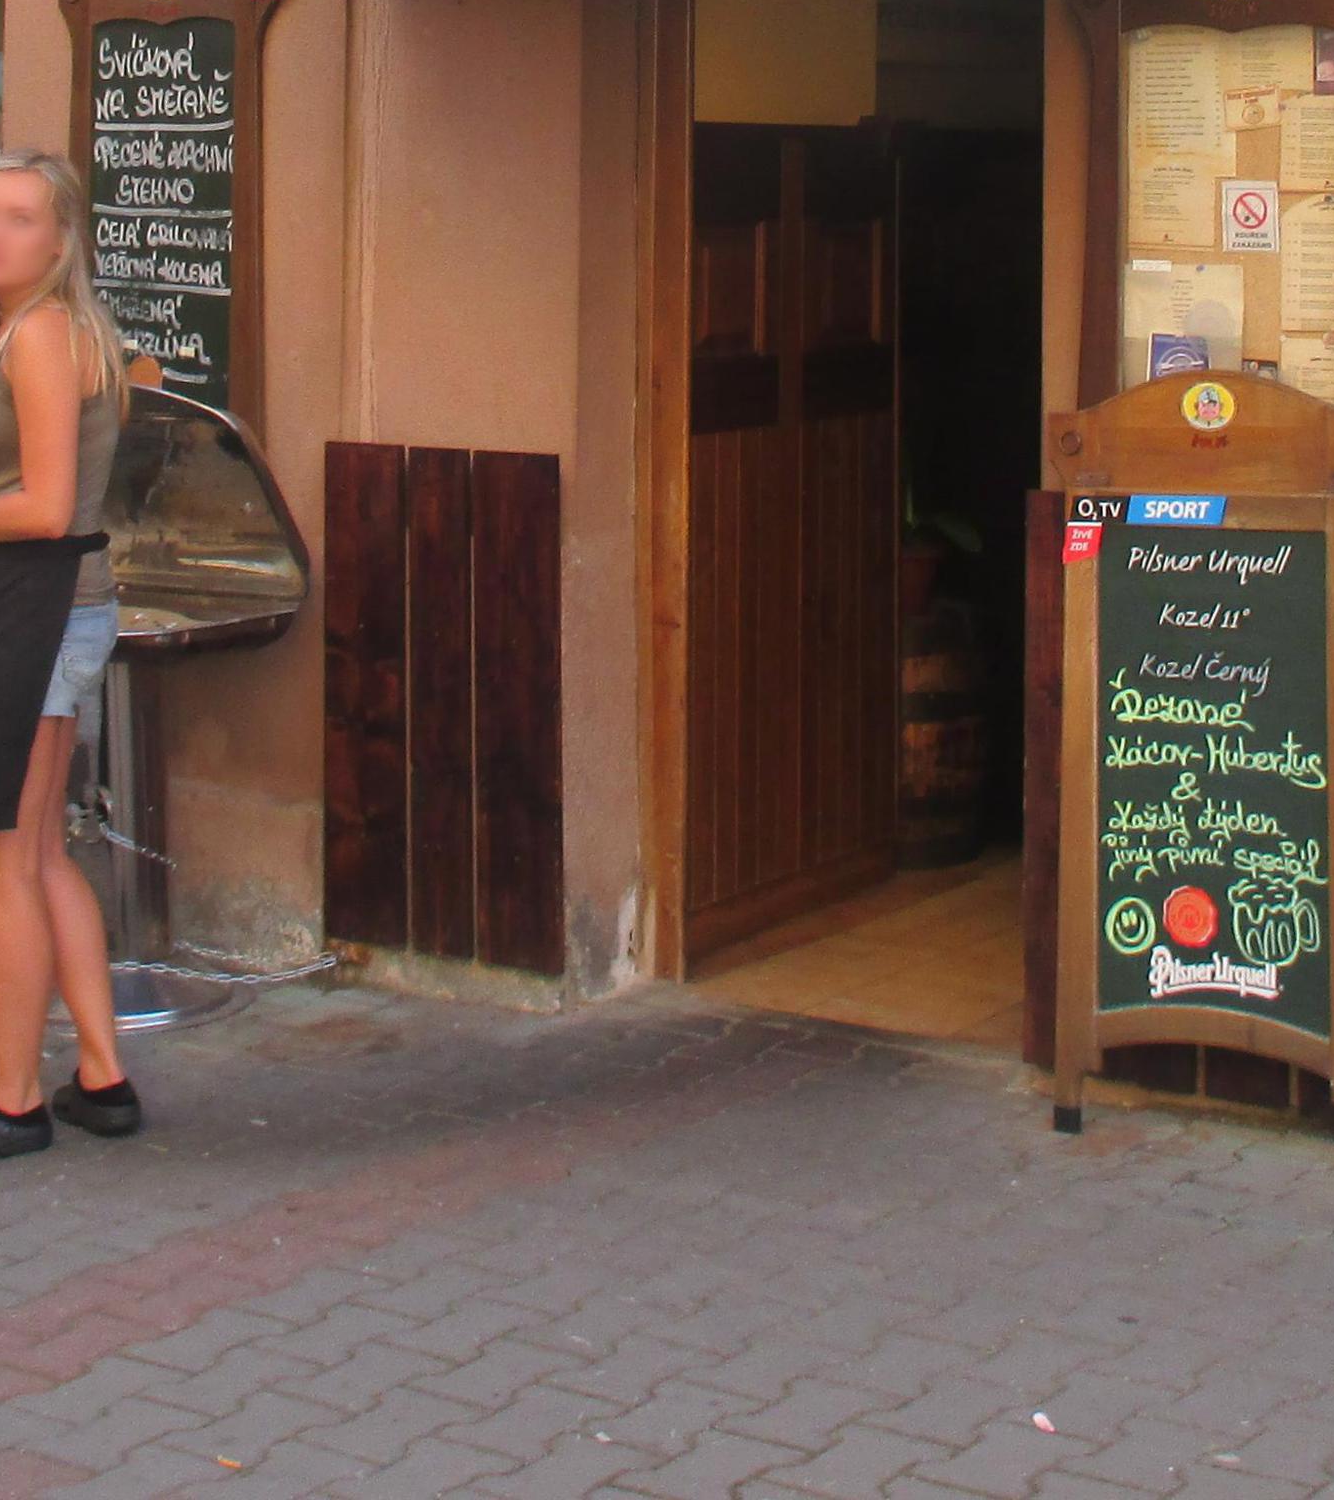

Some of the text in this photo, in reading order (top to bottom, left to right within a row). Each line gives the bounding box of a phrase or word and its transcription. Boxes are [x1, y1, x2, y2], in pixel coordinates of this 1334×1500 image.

[95, 89, 129, 121] NA
[115, 175, 195, 206] STEHNO
[1144, 501, 1210, 518] SPORT
[1128, 544, 1291, 585] Pilsner Urquell
[1158, 603, 1219, 628] Kozel
[1139, 651, 1272, 697] Kozel Černý
[1149, 945, 1278, 998] Pilsner Urquell
